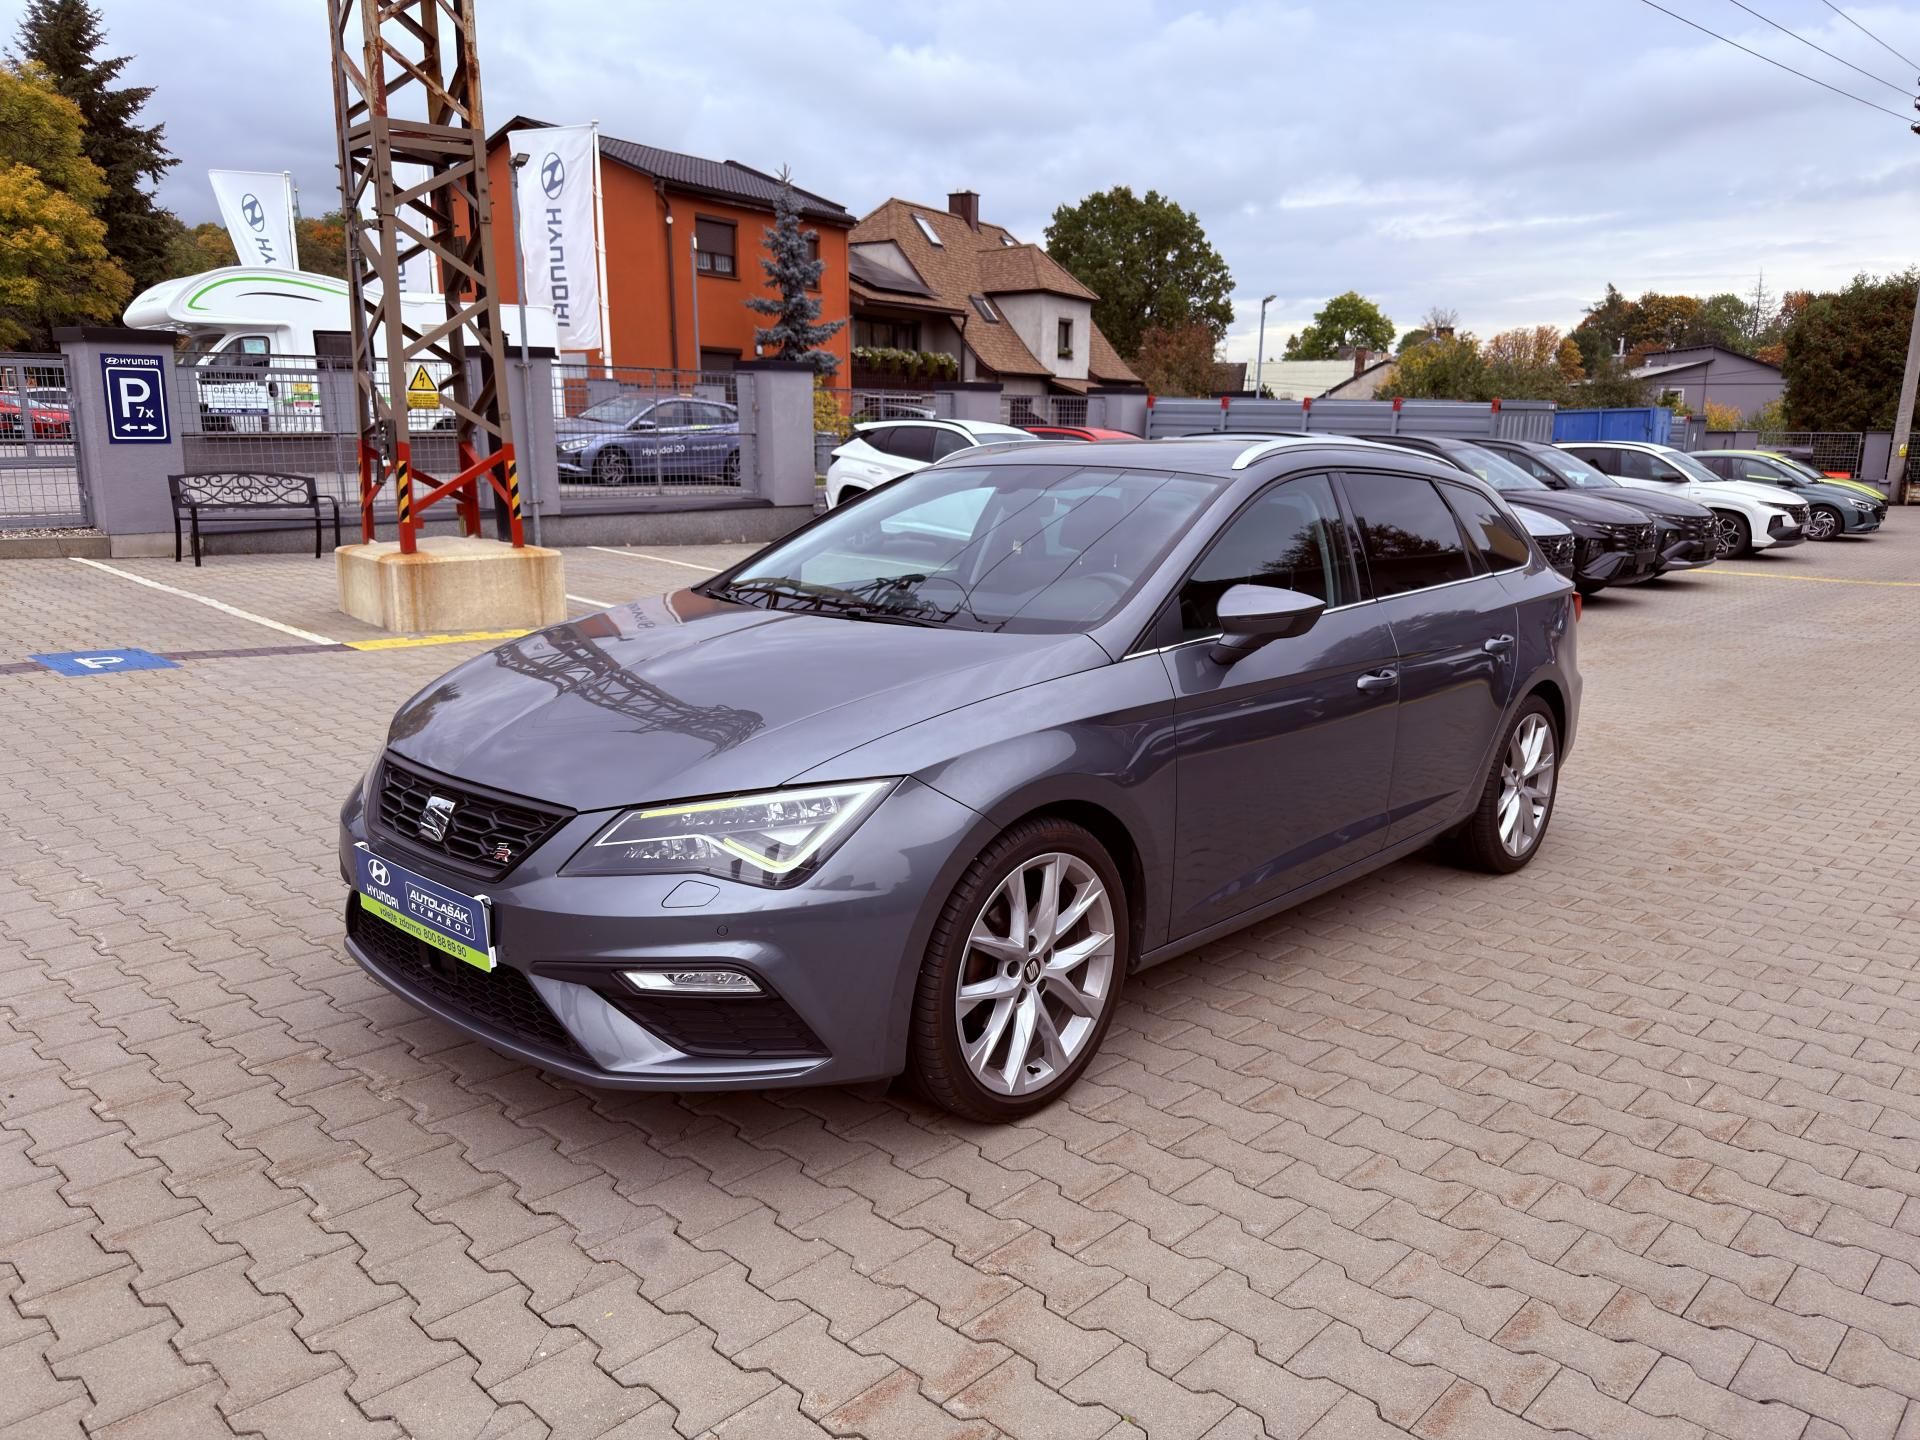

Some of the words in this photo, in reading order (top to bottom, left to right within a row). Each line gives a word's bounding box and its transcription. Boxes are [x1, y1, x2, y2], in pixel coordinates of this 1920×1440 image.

[120, 358, 158, 366] HYUNDAI
[119, 377, 151, 418] P
[136, 406, 155, 418] 7x
[366, 883, 399, 910] HYUNDAI
[409, 889, 469, 924] AUTOLAŠÁK
[379, 908, 398, 924] volejte
[424, 928, 437, 944] 800
[457, 945, 467, 958] 90
